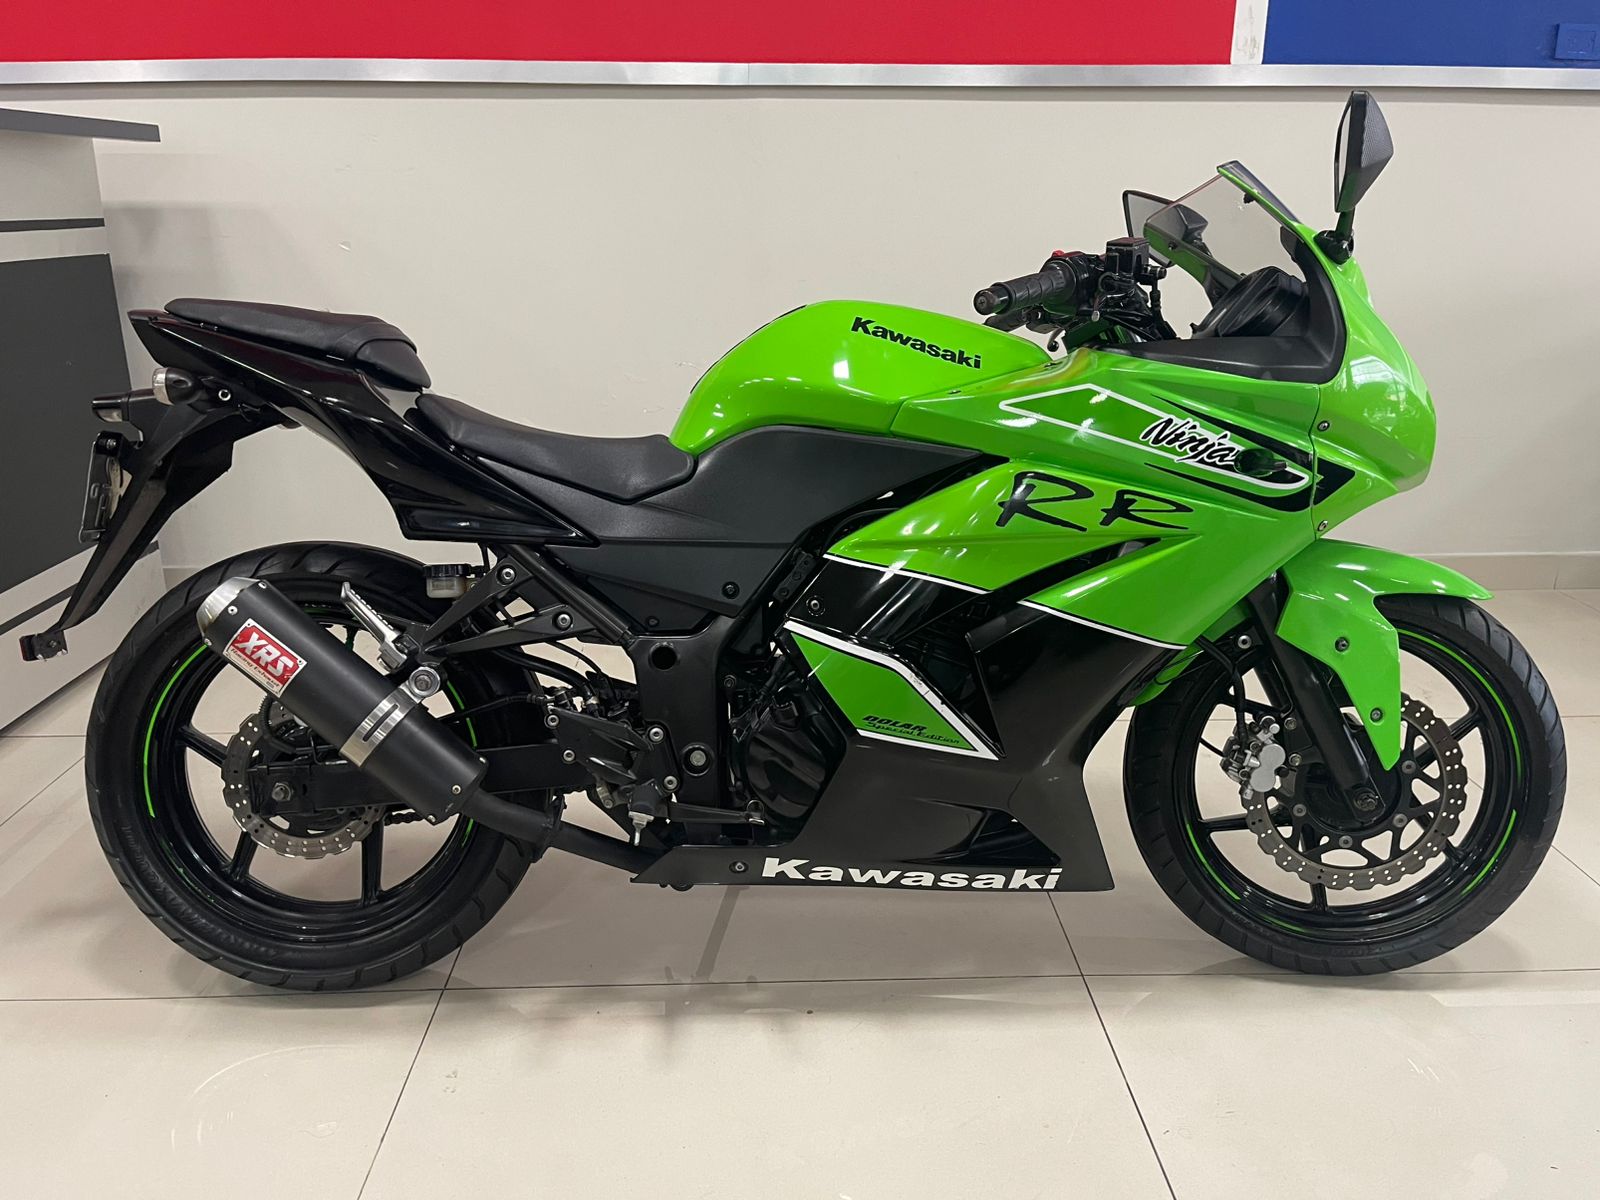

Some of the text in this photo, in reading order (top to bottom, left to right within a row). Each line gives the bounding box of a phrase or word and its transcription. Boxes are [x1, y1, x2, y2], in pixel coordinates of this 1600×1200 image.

[851, 316, 981, 369] Kawasaki
[1140, 417, 1241, 462] Ninja
[234, 631, 295, 677] XRS
[762, 857, 1062, 889] Kawasaki
